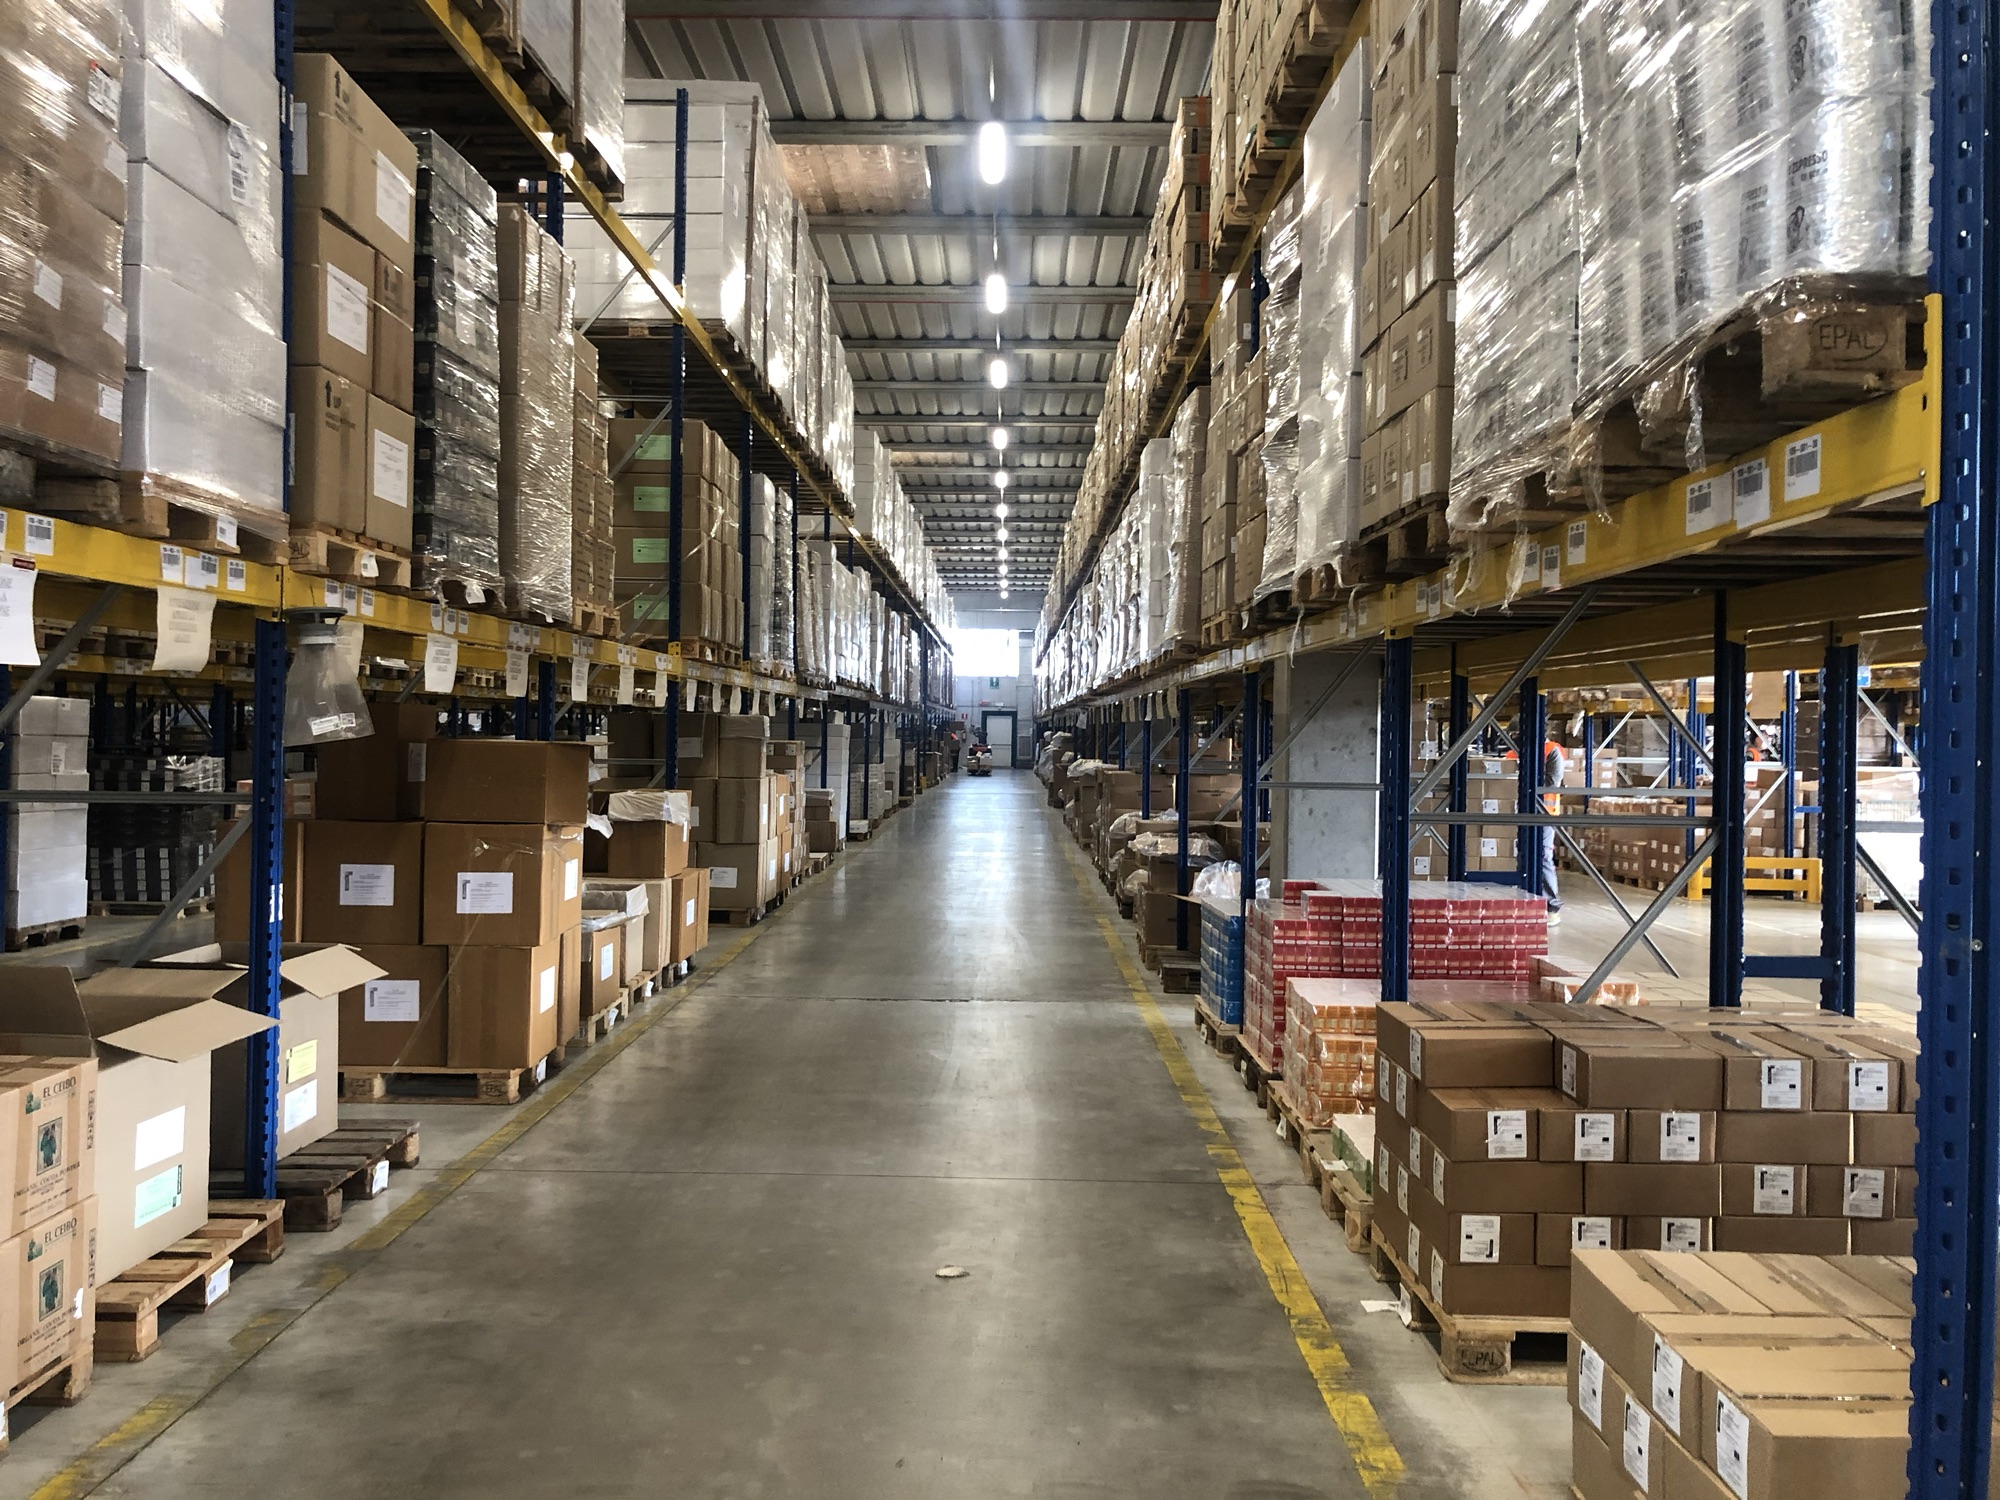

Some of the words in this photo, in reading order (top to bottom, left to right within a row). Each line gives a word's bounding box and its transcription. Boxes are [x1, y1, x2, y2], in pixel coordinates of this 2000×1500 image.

[1819, 324, 1876, 350] EPAL
[44, 1232, 52, 1243] EL
[54, 1217, 77, 1238] CEIBO
